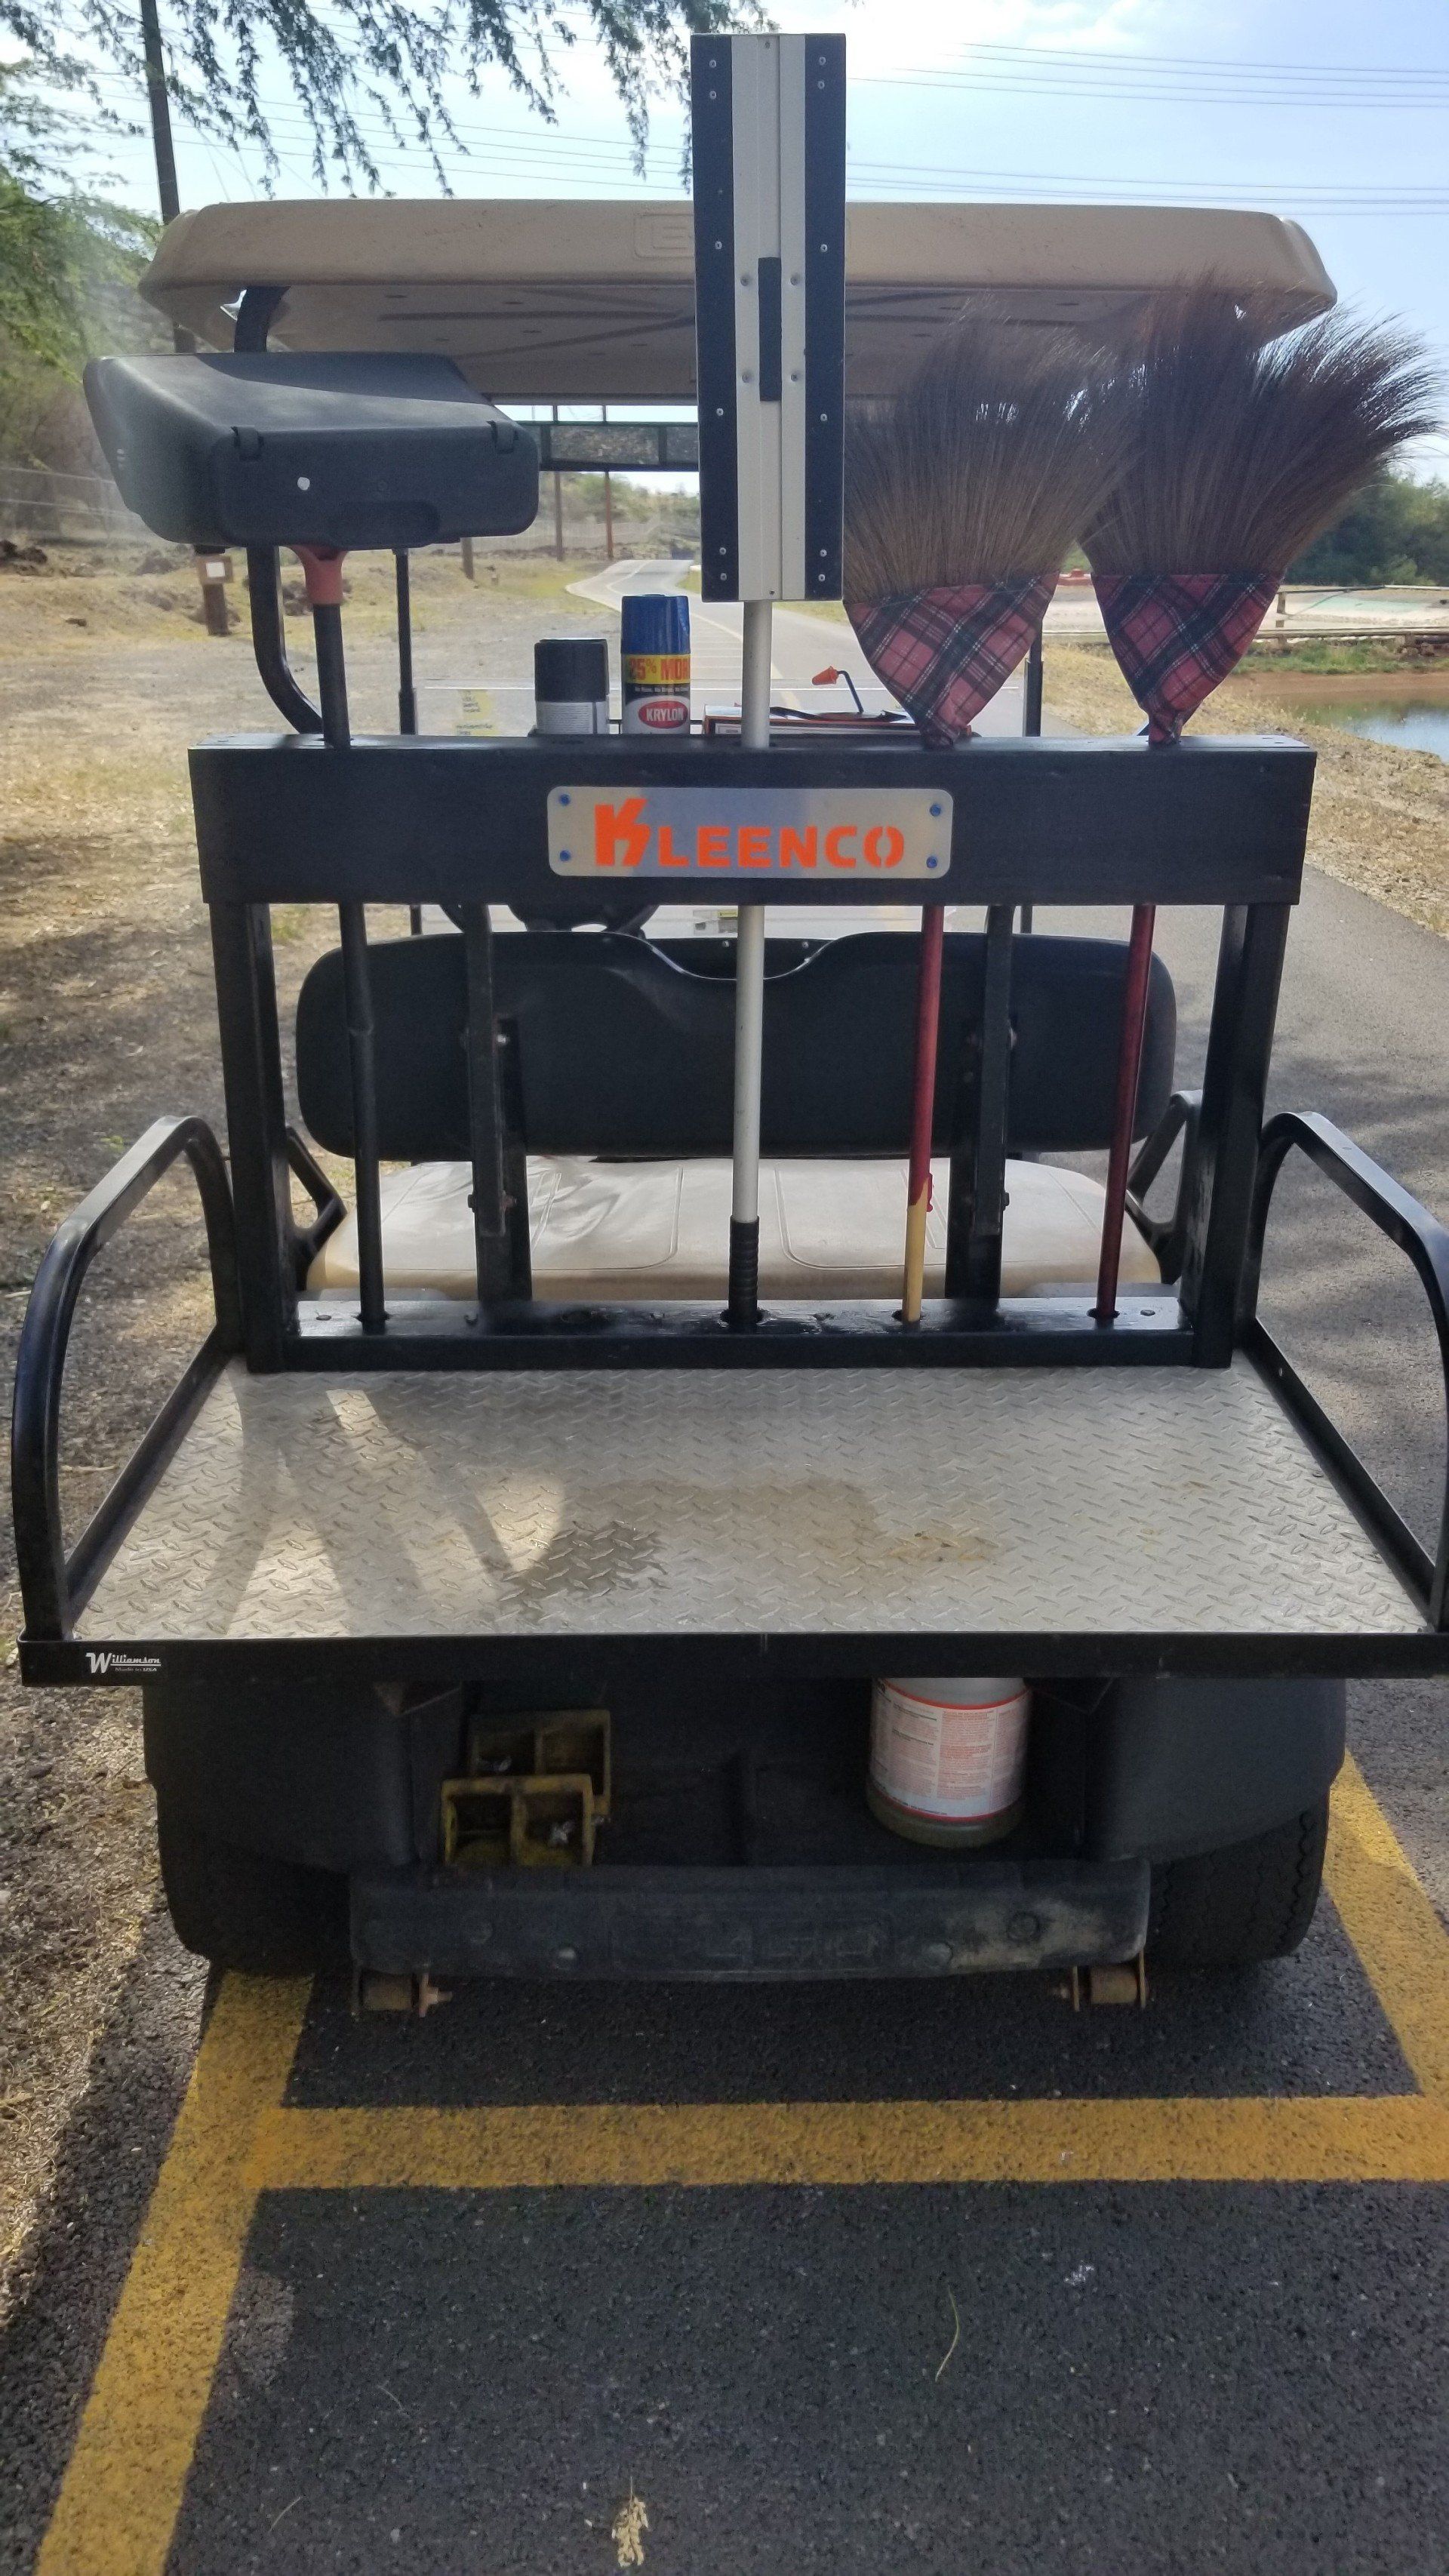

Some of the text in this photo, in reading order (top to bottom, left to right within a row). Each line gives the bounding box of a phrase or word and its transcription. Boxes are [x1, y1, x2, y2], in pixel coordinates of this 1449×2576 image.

[627, 657, 657, 681] 25%
[646, 707, 684, 722] KRYLON
[594, 798, 904, 869] KLEENCO
[85, 1652, 161, 1673] Williamson
